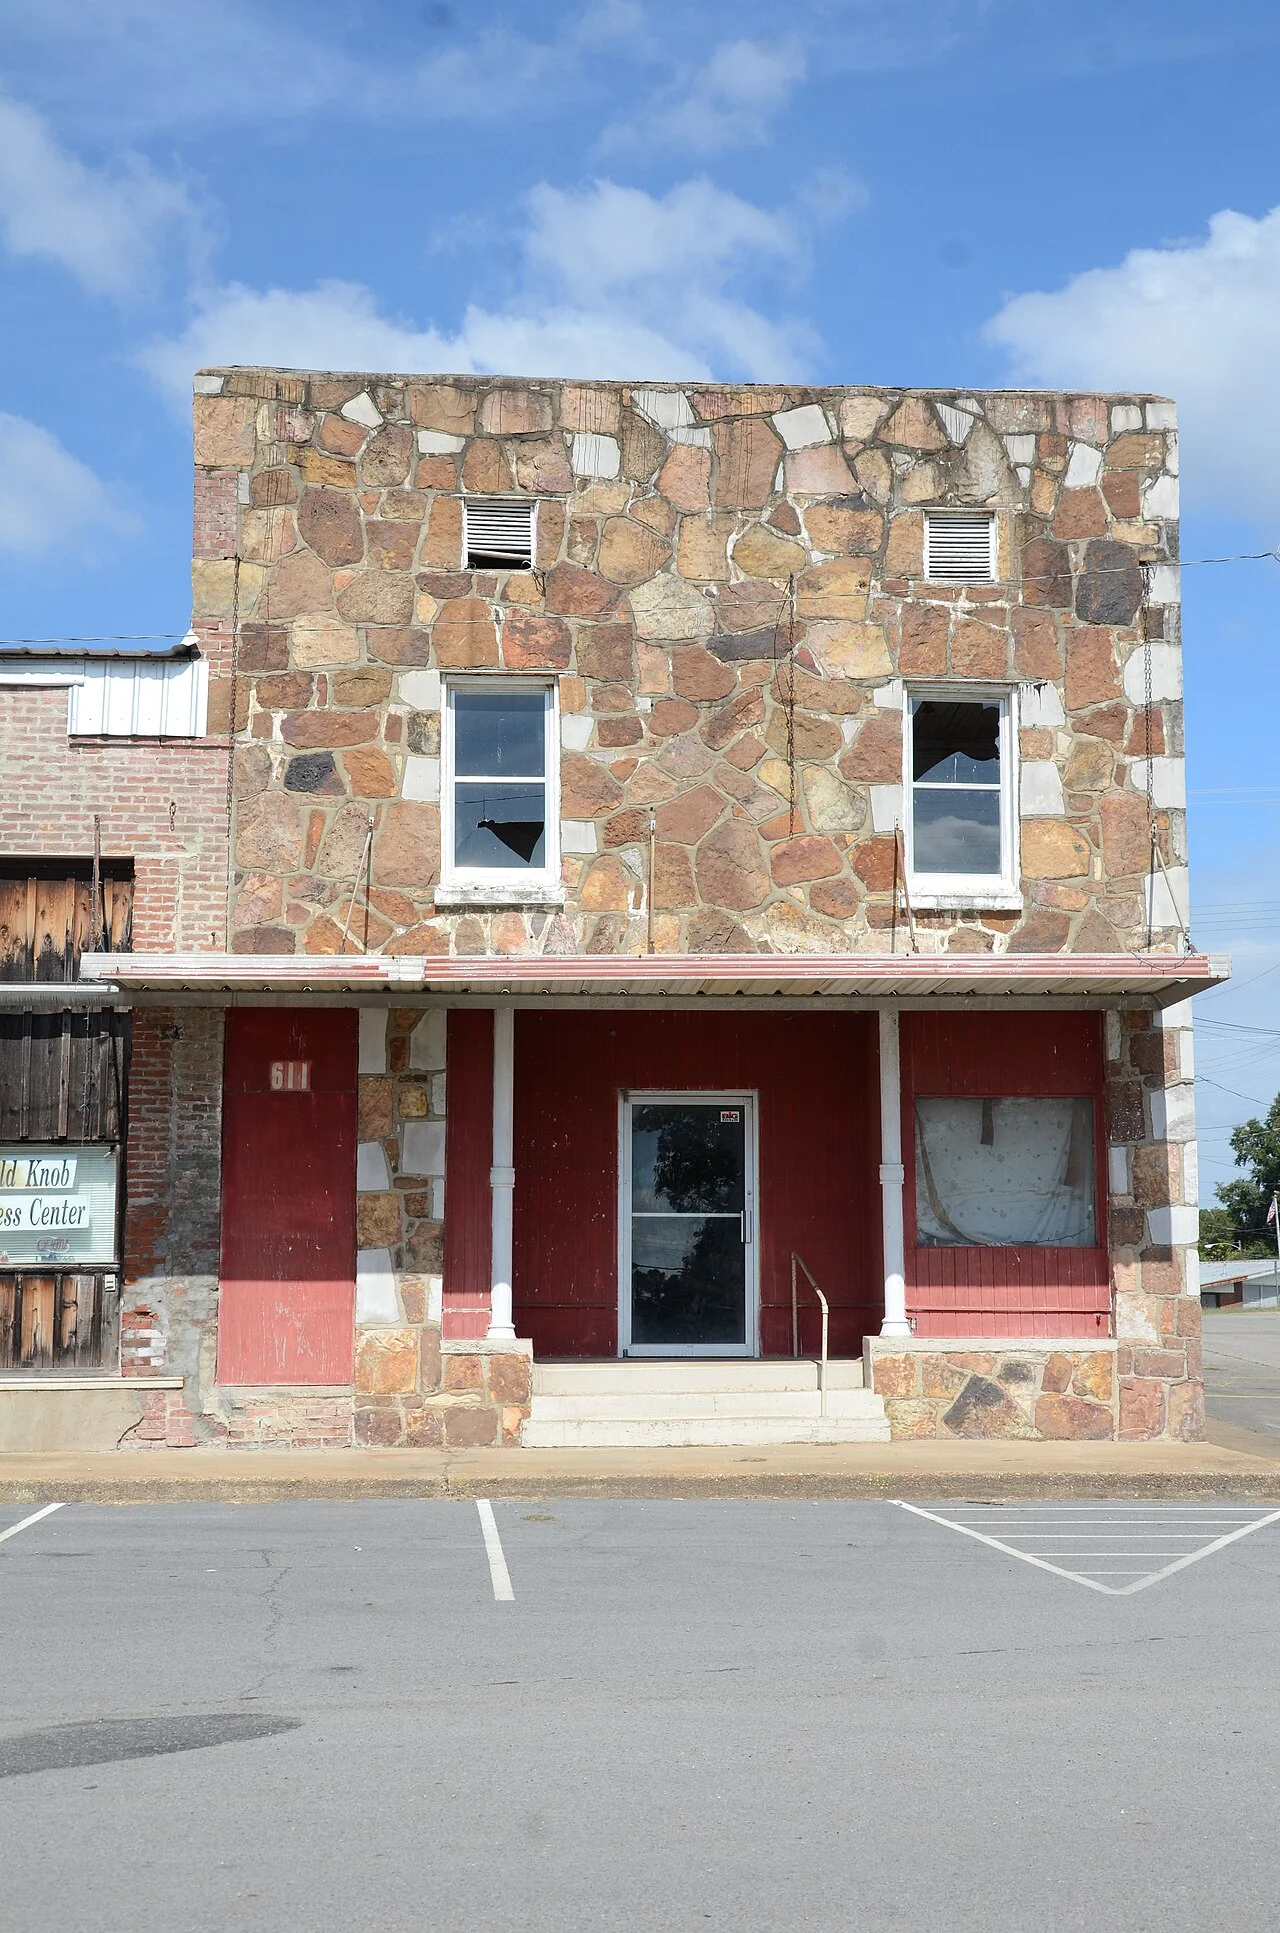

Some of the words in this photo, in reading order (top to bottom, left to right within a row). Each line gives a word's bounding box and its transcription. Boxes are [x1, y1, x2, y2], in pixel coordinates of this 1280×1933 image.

[271, 1062, 308, 1090] 611
[25, 1159, 70, 1187] Knob
[30, 1198, 86, 1226] Center
